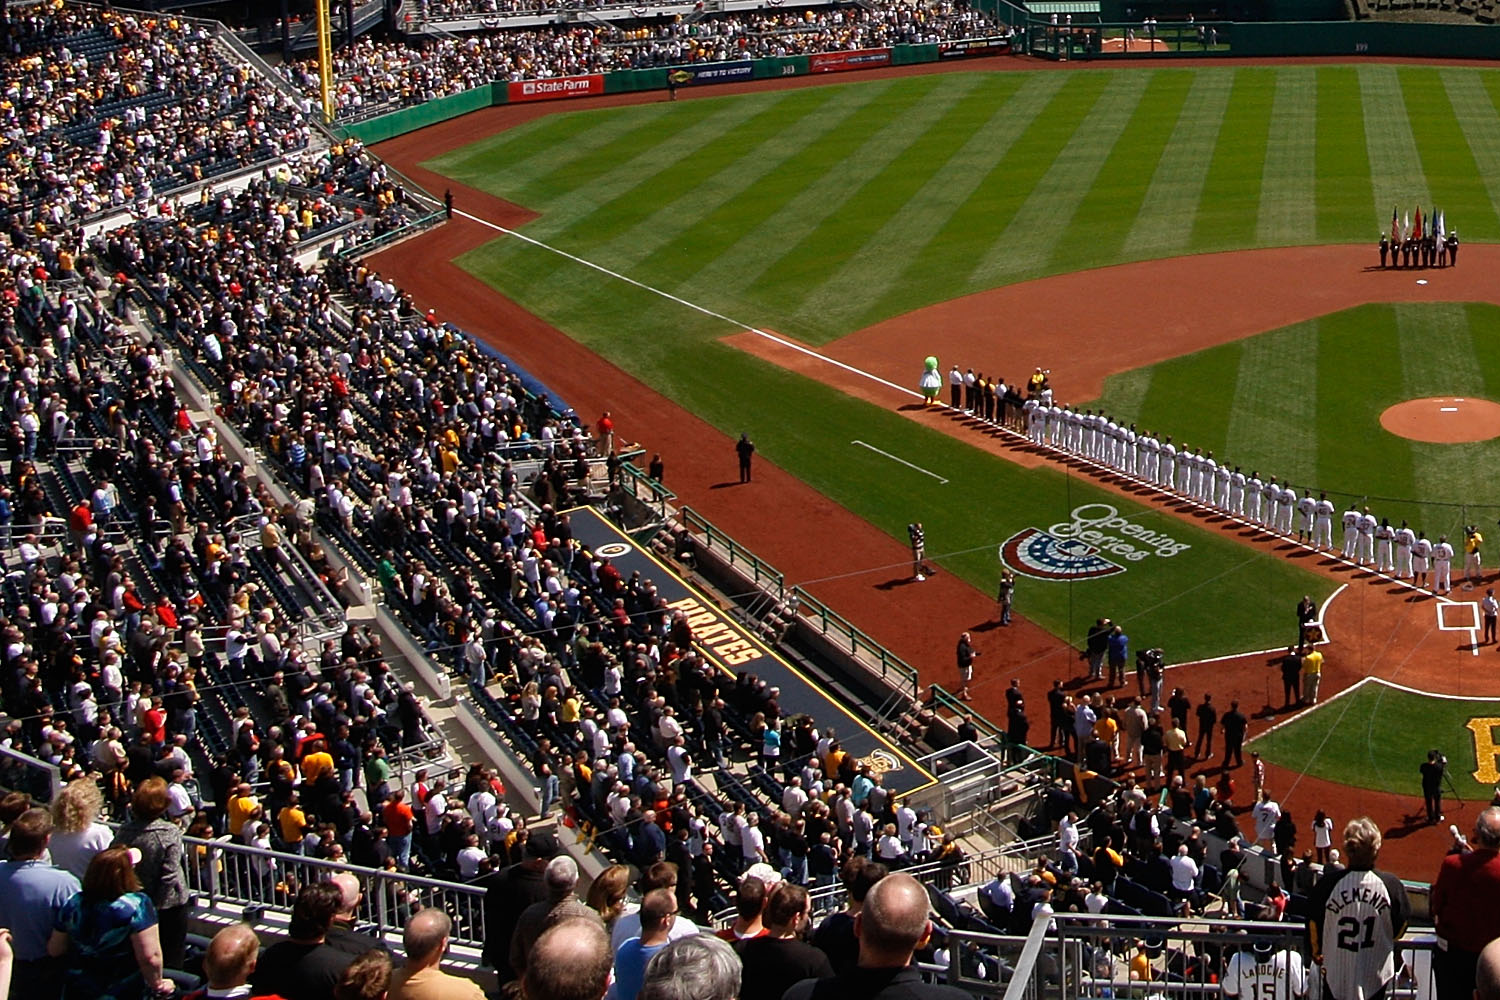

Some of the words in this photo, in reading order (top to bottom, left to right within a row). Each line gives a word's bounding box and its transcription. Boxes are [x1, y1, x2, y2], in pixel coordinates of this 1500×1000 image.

[1049, 520, 1150, 561] Series
[1071, 503, 1191, 557] Opening
[666, 598, 762, 665] PIRATES
[1327, 888, 1392, 915] CLEMENTE
[1337, 916, 1376, 952] 21
